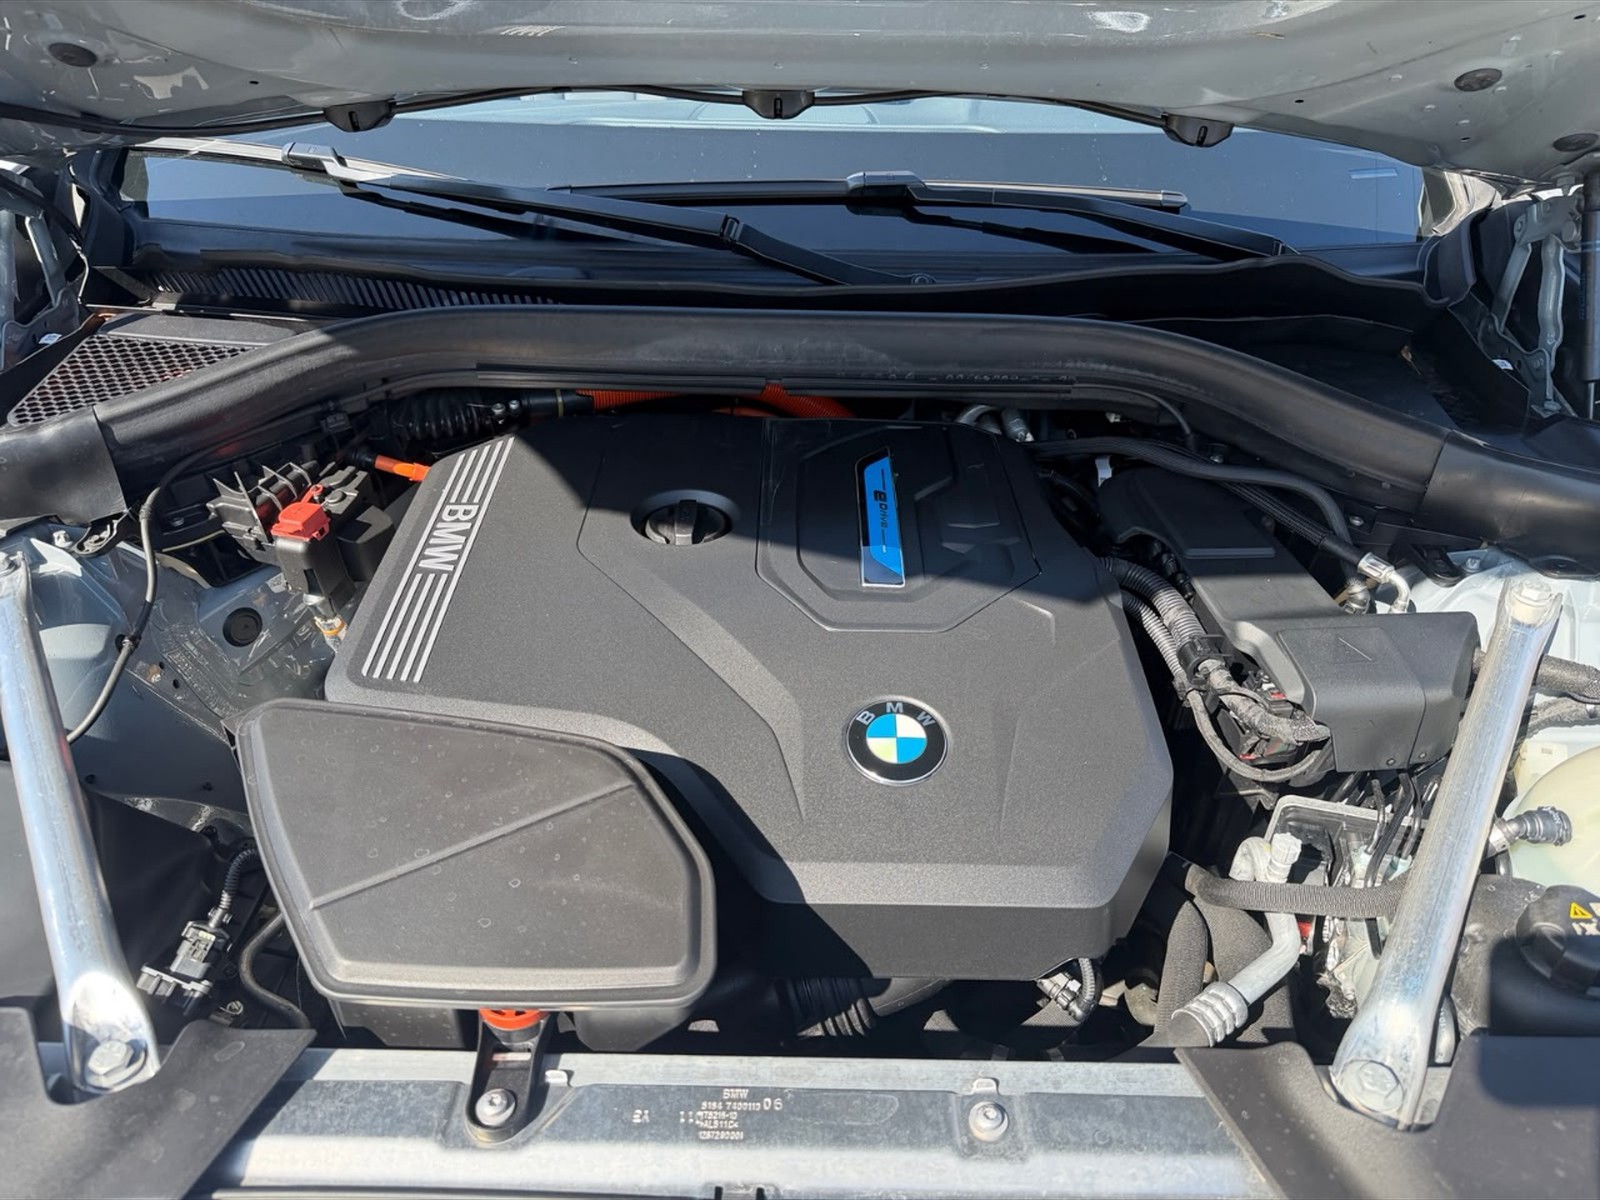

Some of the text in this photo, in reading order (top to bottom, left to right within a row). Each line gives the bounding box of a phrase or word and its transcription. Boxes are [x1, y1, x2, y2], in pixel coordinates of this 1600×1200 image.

[418, 504, 479, 571] BMW
[856, 702, 936, 727] BMW
[723, 1089, 749, 1099] BMW
